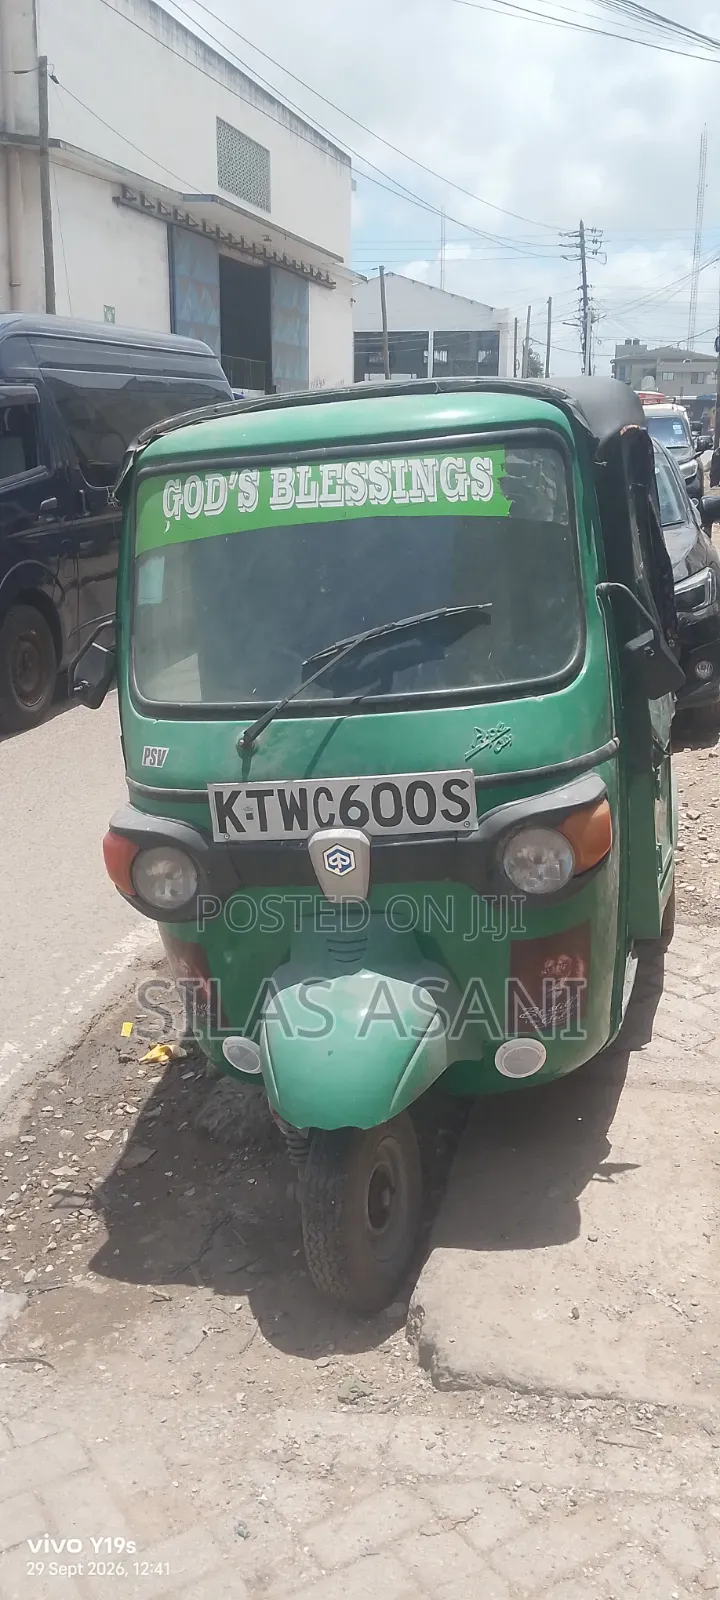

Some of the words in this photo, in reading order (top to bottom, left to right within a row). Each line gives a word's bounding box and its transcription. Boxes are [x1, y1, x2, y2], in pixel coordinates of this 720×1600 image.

[162, 468, 260, 521] GOD'S
[269, 456, 493, 511] BLESSINGS
[143, 747, 168, 767] PSV
[213, 778, 471, 834] KTWC600S
